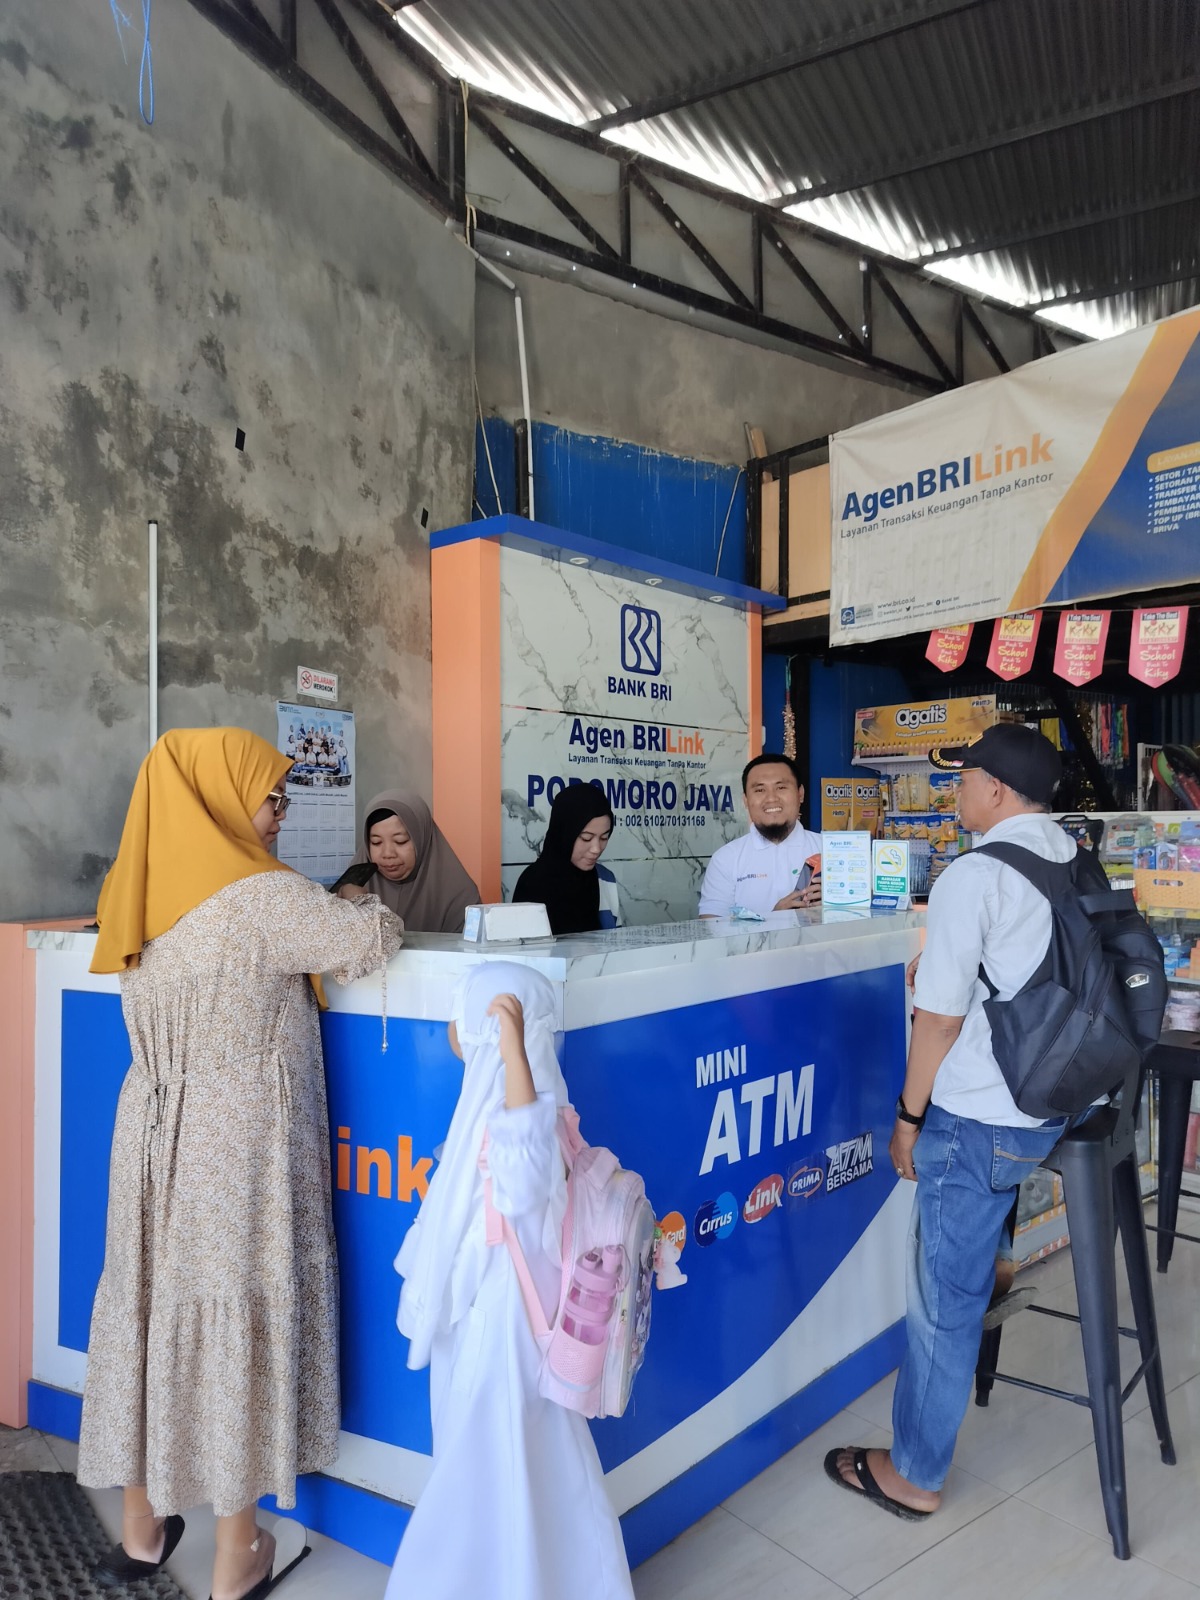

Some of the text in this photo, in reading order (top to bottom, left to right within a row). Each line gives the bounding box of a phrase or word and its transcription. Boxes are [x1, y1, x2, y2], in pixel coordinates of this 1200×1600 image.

[841, 432, 1054, 522] AgenBRILink
[1154, 470, 1181, 483] SETOR
[1154, 476, 1194, 492] SETORAN
[1154, 484, 1197, 500] TRANSFER
[840, 472, 1054, 539] Layanan Transaksi Keuangan Tanpa Kantor
[1153, 509, 1200, 526] TOP UP (BR
[1153, 522, 1179, 534] BRIVA
[937, 638, 965, 651] School
[998, 645, 1028, 658] School
[937, 654, 958, 668] Kiky
[1064, 650, 1096, 661] School
[1139, 649, 1176, 661] School
[999, 662, 1021, 675] Kiky
[1067, 667, 1091, 680] Kiky
[1144, 668, 1169, 680] Kiky
[608, 676, 672, 702] BANK BRI
[896, 703, 946, 730] agatis
[569, 718, 705, 756] Agen BRILink
[568, 752, 707, 774] Layanan Transaksi Keuangan Tanpa Kantor
[528, 774, 735, 813] POMORO JAYA
[625, 814, 642, 827] 002
[695, 1044, 747, 1089] MINI
[699, 1063, 815, 1177] ATM
[337, 1126, 434, 1203] ink
[827, 1159, 873, 1192] BERSAMA
[699, 1211, 733, 1236] Cirrus
[744, 1182, 783, 1215] Link
[791, 1170, 821, 1194] PRIMA
